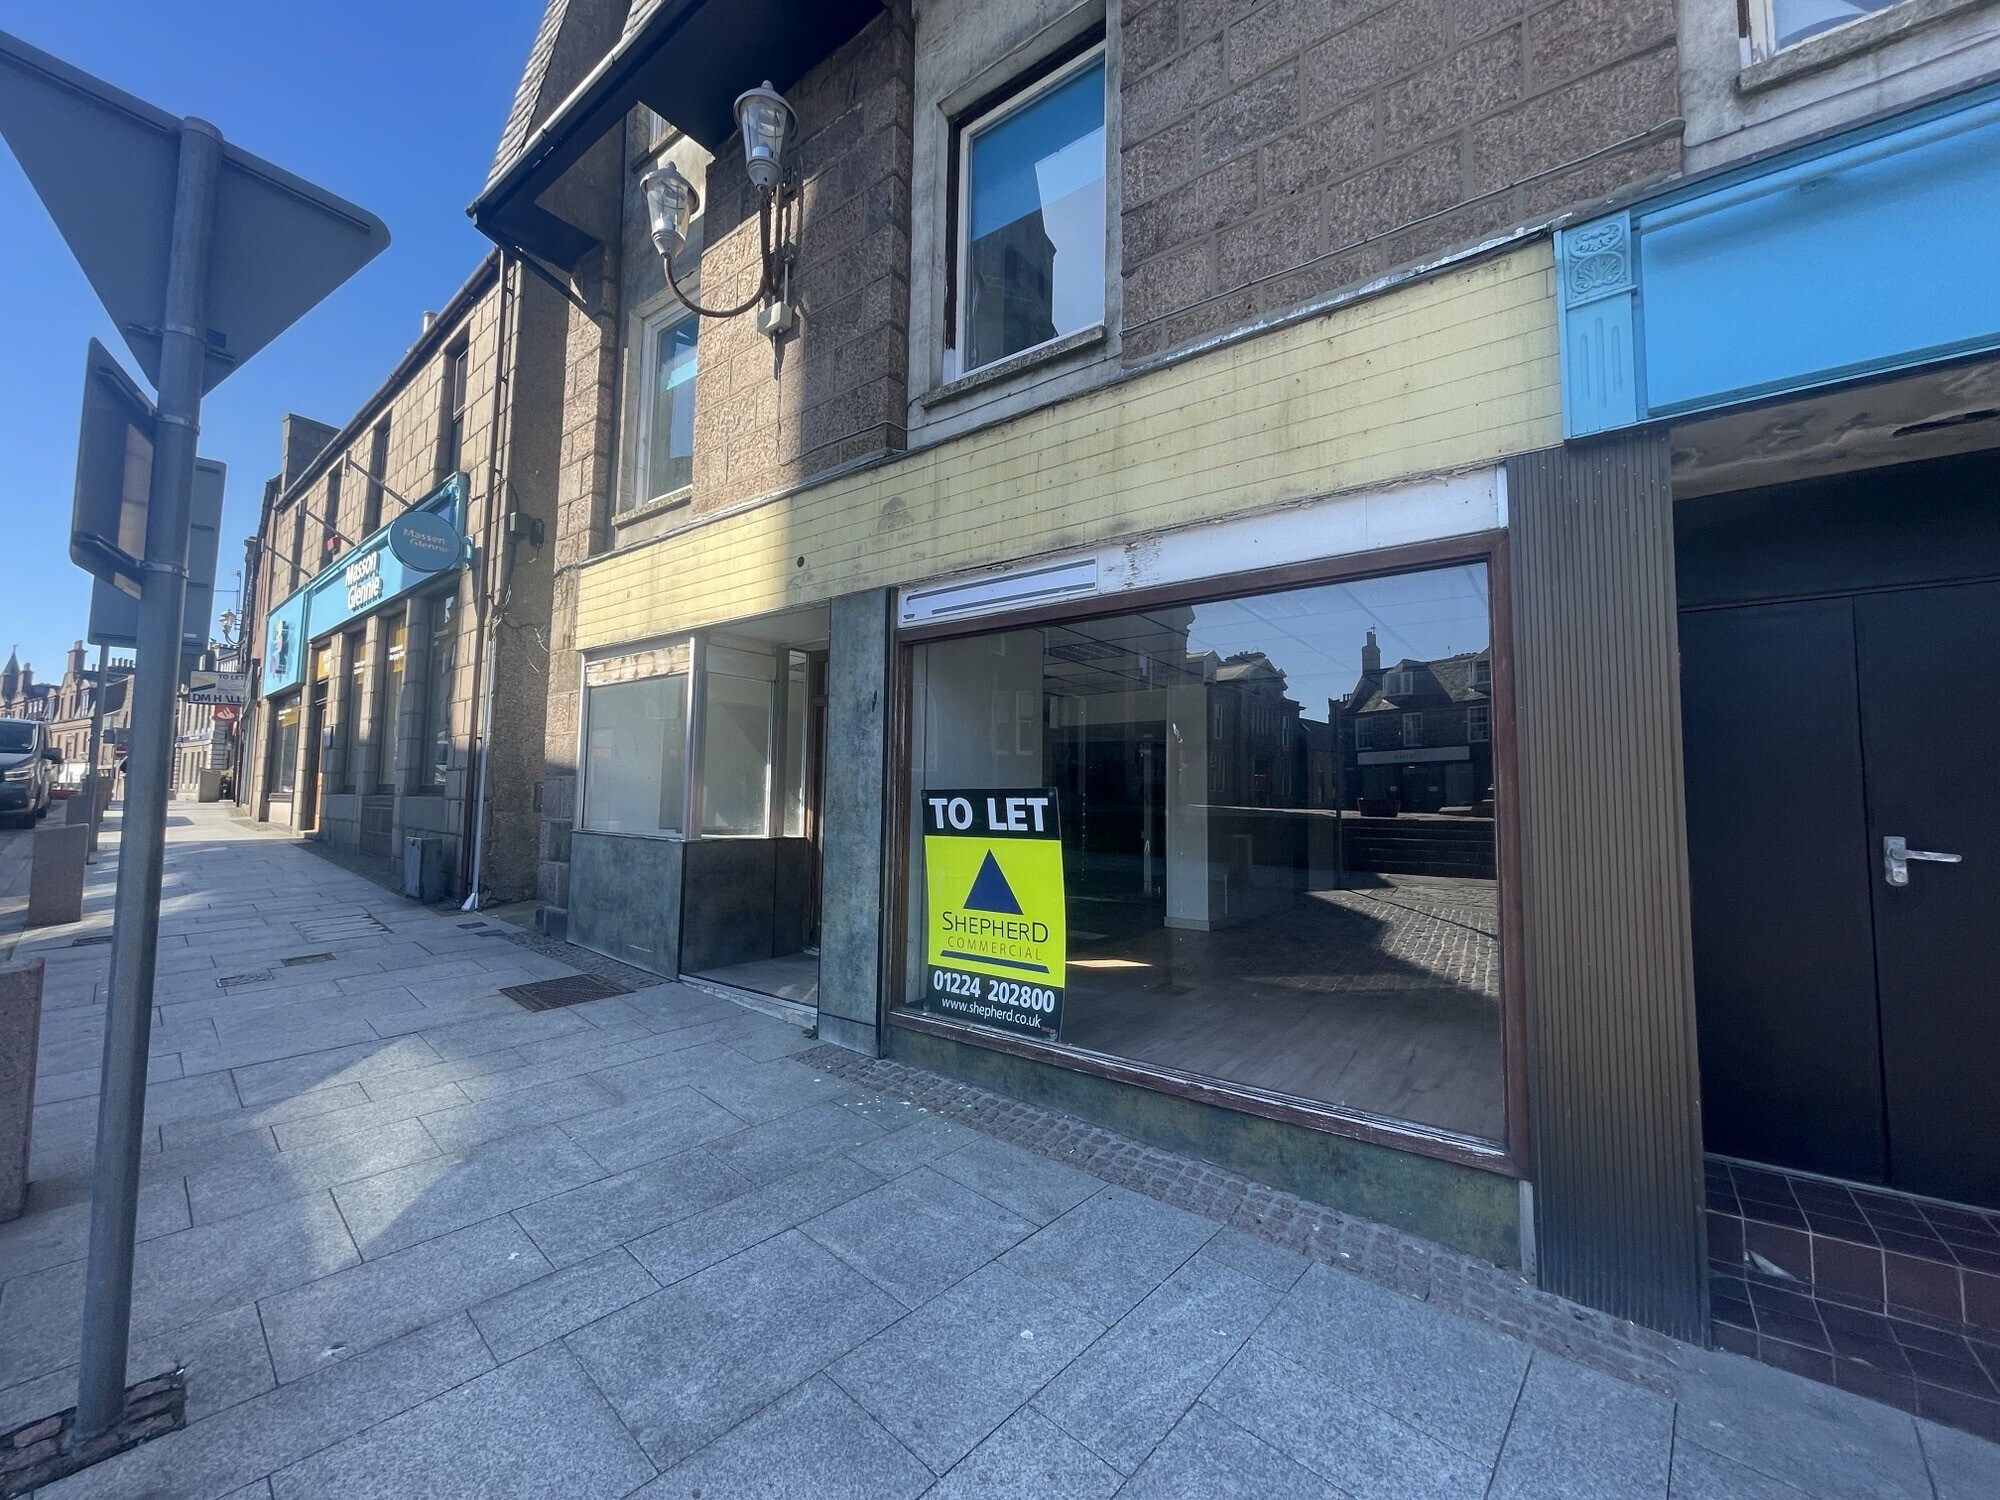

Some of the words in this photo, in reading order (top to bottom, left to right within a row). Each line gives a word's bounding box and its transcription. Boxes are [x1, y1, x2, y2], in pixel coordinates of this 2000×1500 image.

[345, 551, 378, 587] Masson
[348, 575, 380, 610] Glennie
[193, 693, 211, 702] DM
[929, 797, 973, 830] TO
[987, 797, 1049, 832] LET
[942, 911, 1049, 943] SHEPHERD
[947, 935, 1042, 960] COMMERCIAL
[933, 970, 981, 998] 01224
[987, 980, 1055, 1013] 202800
[941, 998, 1041, 1029] www.shepherd.co.uk
